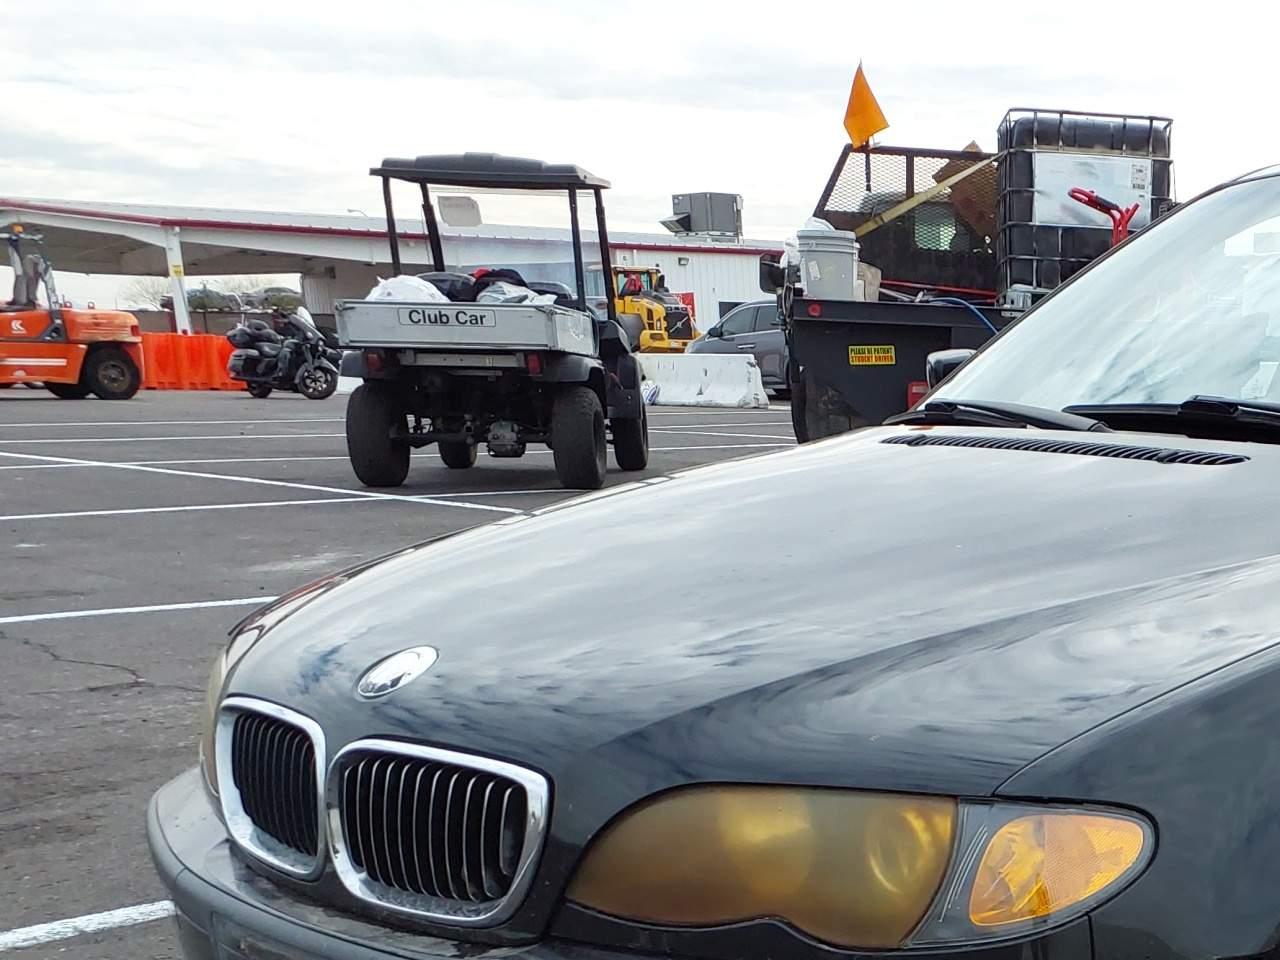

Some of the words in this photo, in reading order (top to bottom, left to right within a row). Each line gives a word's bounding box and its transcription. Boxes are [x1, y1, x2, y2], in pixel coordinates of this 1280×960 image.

[408, 309, 450, 325] Club
[455, 310, 486, 325] Car
[850, 355, 874, 363] STUDENT
[874, 355, 894, 363] DRIVER
